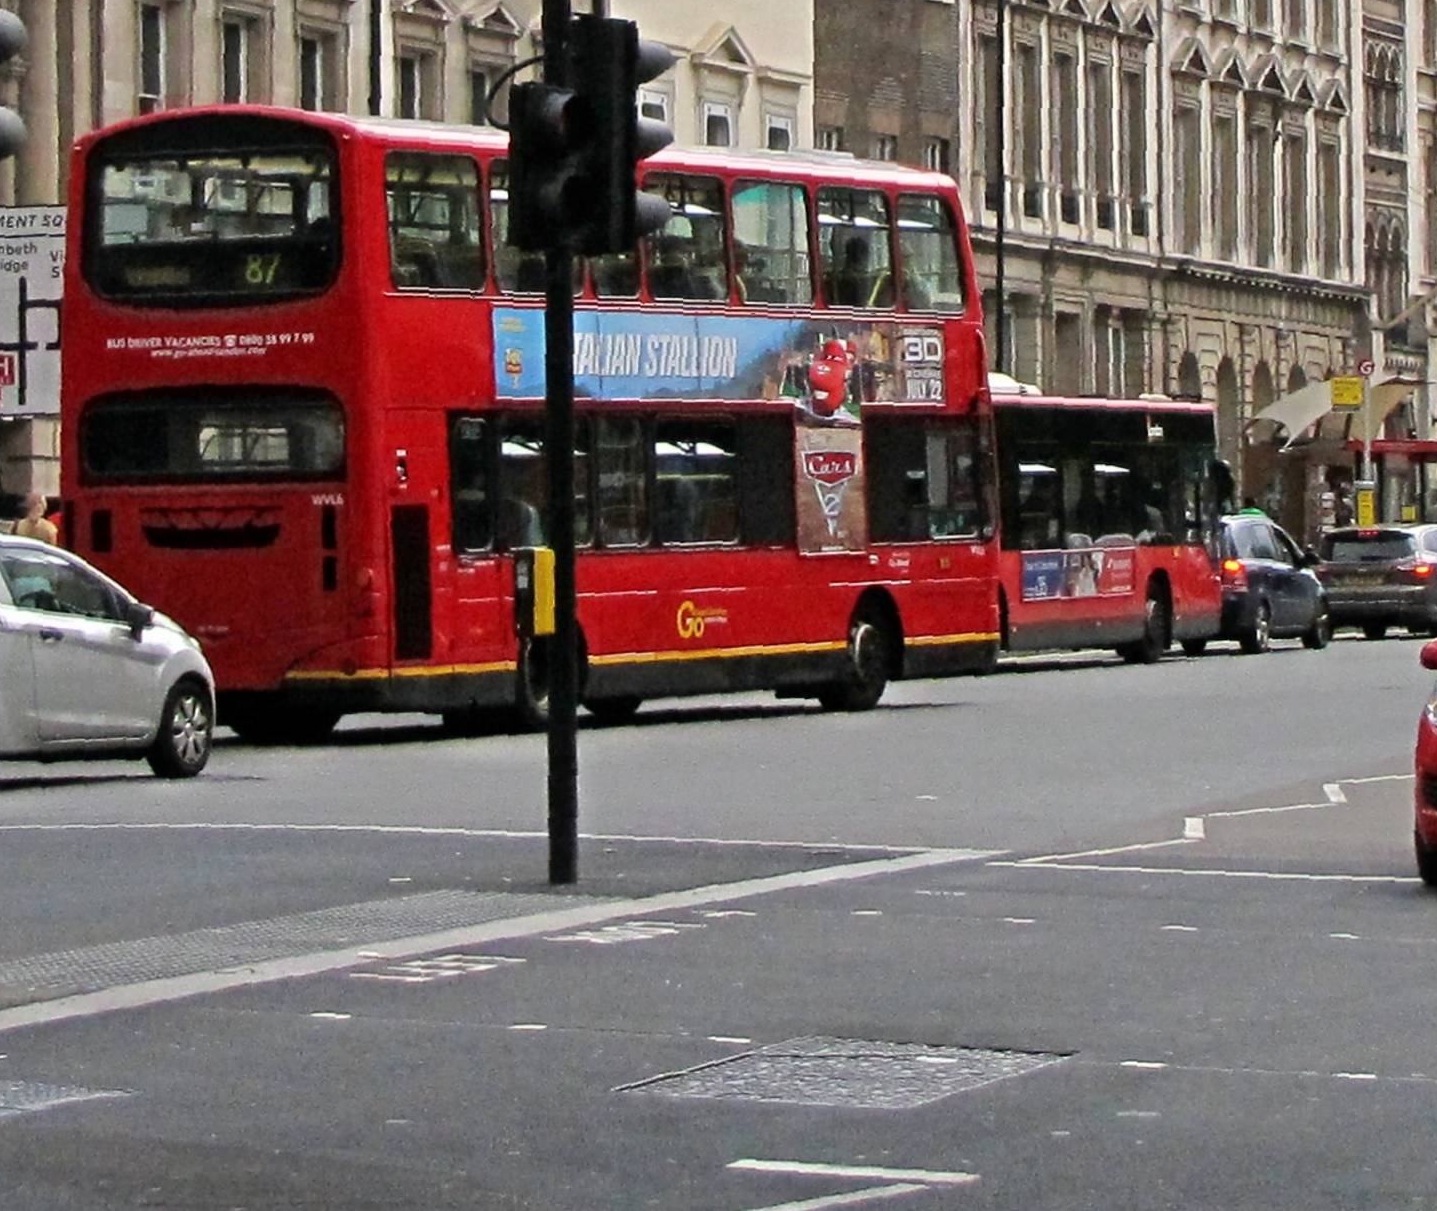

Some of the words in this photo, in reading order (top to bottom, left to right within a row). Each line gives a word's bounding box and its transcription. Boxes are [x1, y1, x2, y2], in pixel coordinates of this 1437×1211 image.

[245, 253, 281, 284] 87
[106, 338, 127, 349] BUS
[127, 337, 163, 349] DRIVER
[164, 335, 222, 348] VACANCIES
[573, 331, 642, 377] TALIAN
[646, 334, 738, 379] STALLION
[903, 337, 942, 363] 3D
[807, 455, 852, 476] Cars
[676, 600, 705, 639] Go
